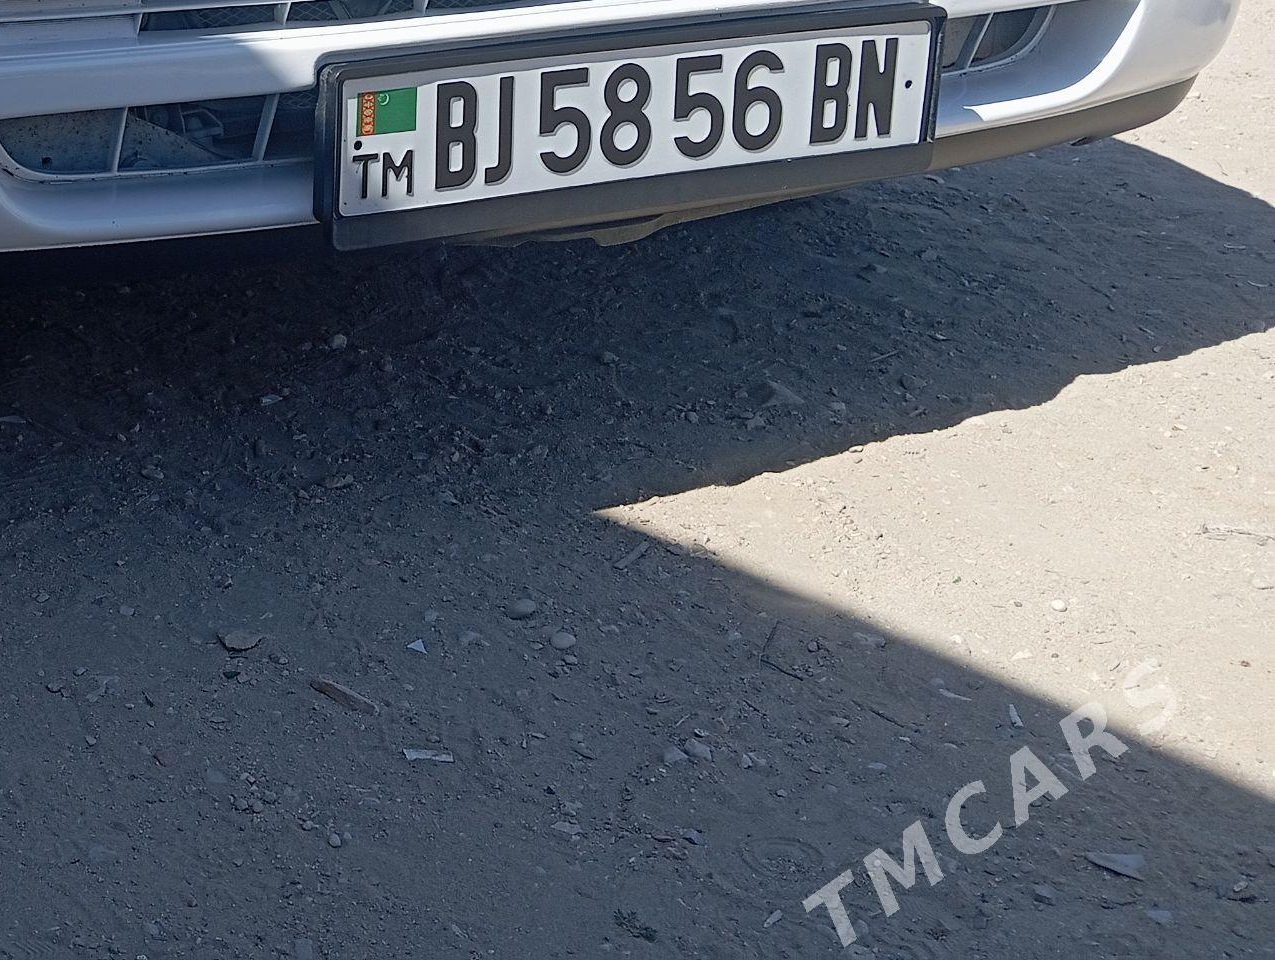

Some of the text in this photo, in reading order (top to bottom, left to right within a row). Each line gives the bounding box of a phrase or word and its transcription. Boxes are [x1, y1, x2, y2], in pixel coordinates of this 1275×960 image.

[353, 149, 415, 200] TM
[434, 76, 515, 191] BJ
[808, 37, 900, 146] BN
